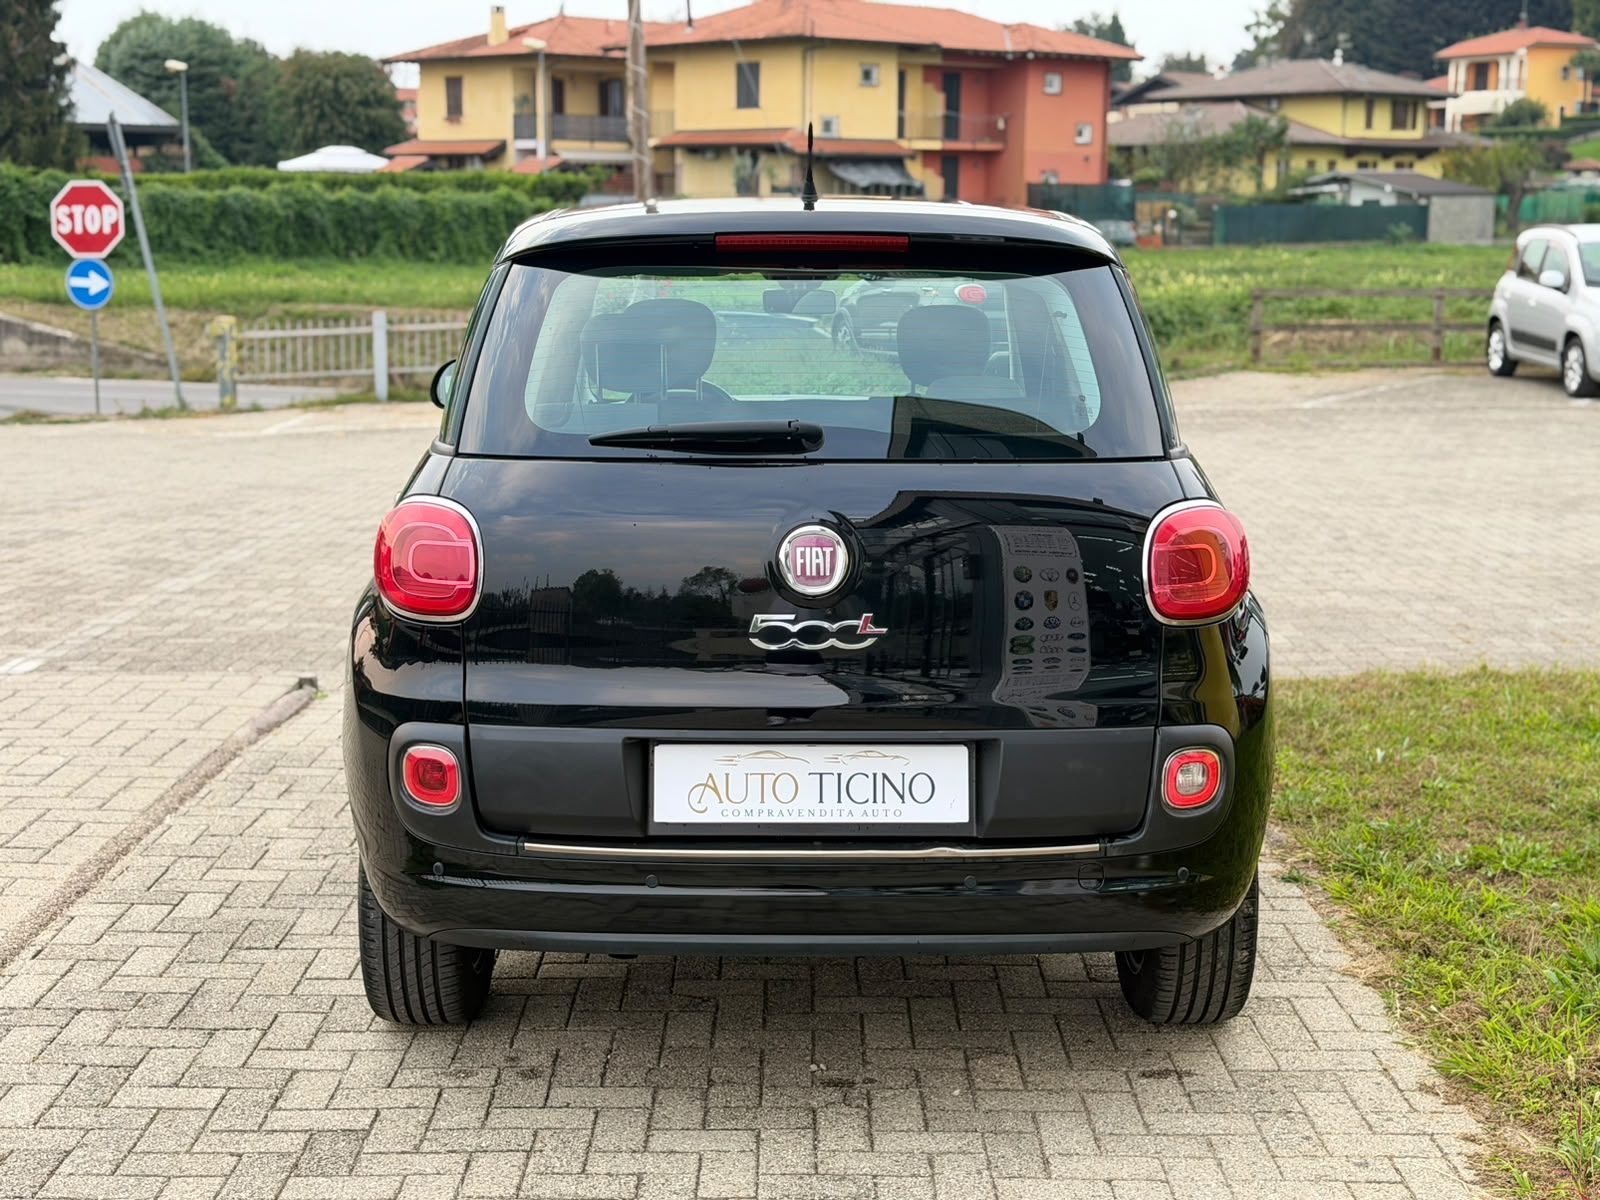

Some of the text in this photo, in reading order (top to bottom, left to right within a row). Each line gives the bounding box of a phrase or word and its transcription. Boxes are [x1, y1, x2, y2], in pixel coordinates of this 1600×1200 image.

[56, 204, 118, 235] STOP
[796, 547, 834, 577] FIAT
[749, 613, 889, 650] 500L
[687, 771, 936, 814] AUTO TICINO
[721, 808, 903, 818] COMPRAVENDITA AUTO
